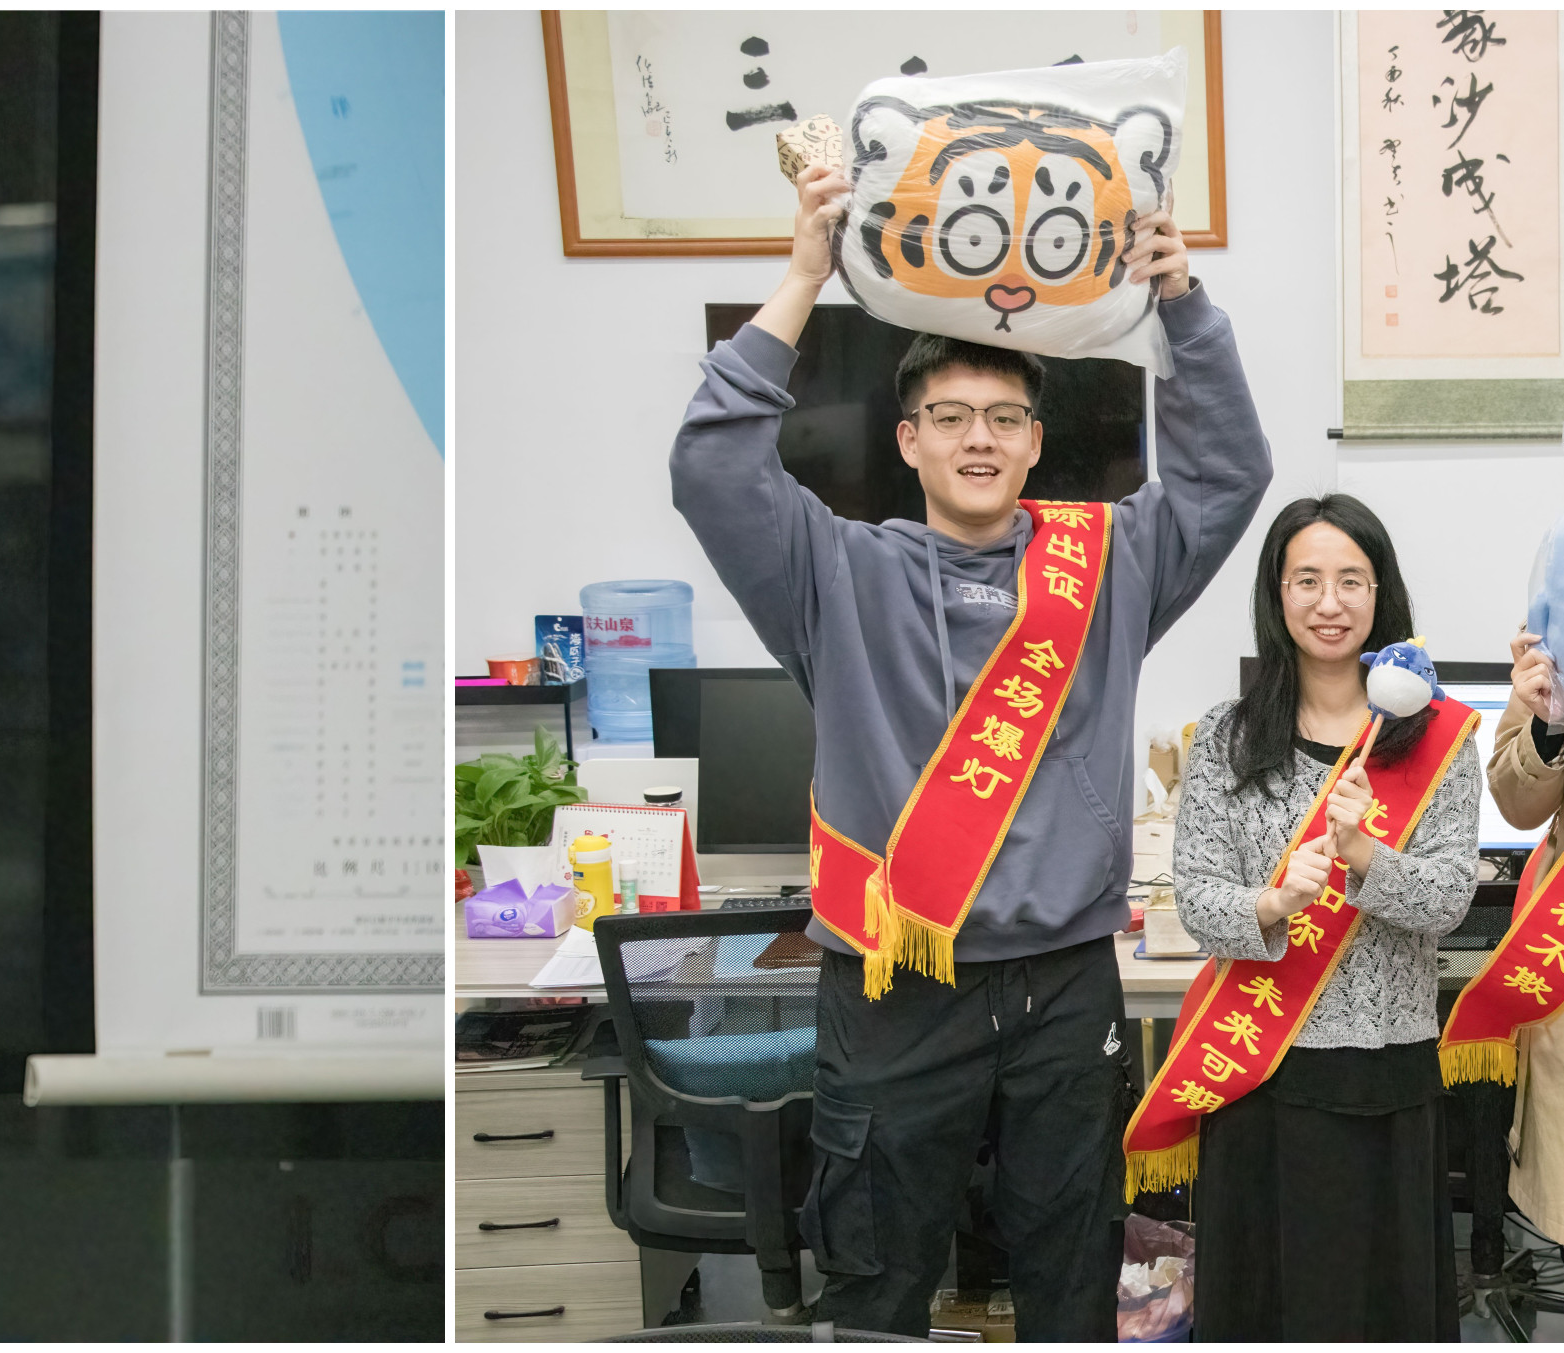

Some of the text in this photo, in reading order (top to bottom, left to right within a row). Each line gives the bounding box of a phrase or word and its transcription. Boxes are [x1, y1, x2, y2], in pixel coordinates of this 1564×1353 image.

[949, 639, 1066, 800] 全场爆灯
[1170, 974, 1285, 1114] 未来可期
